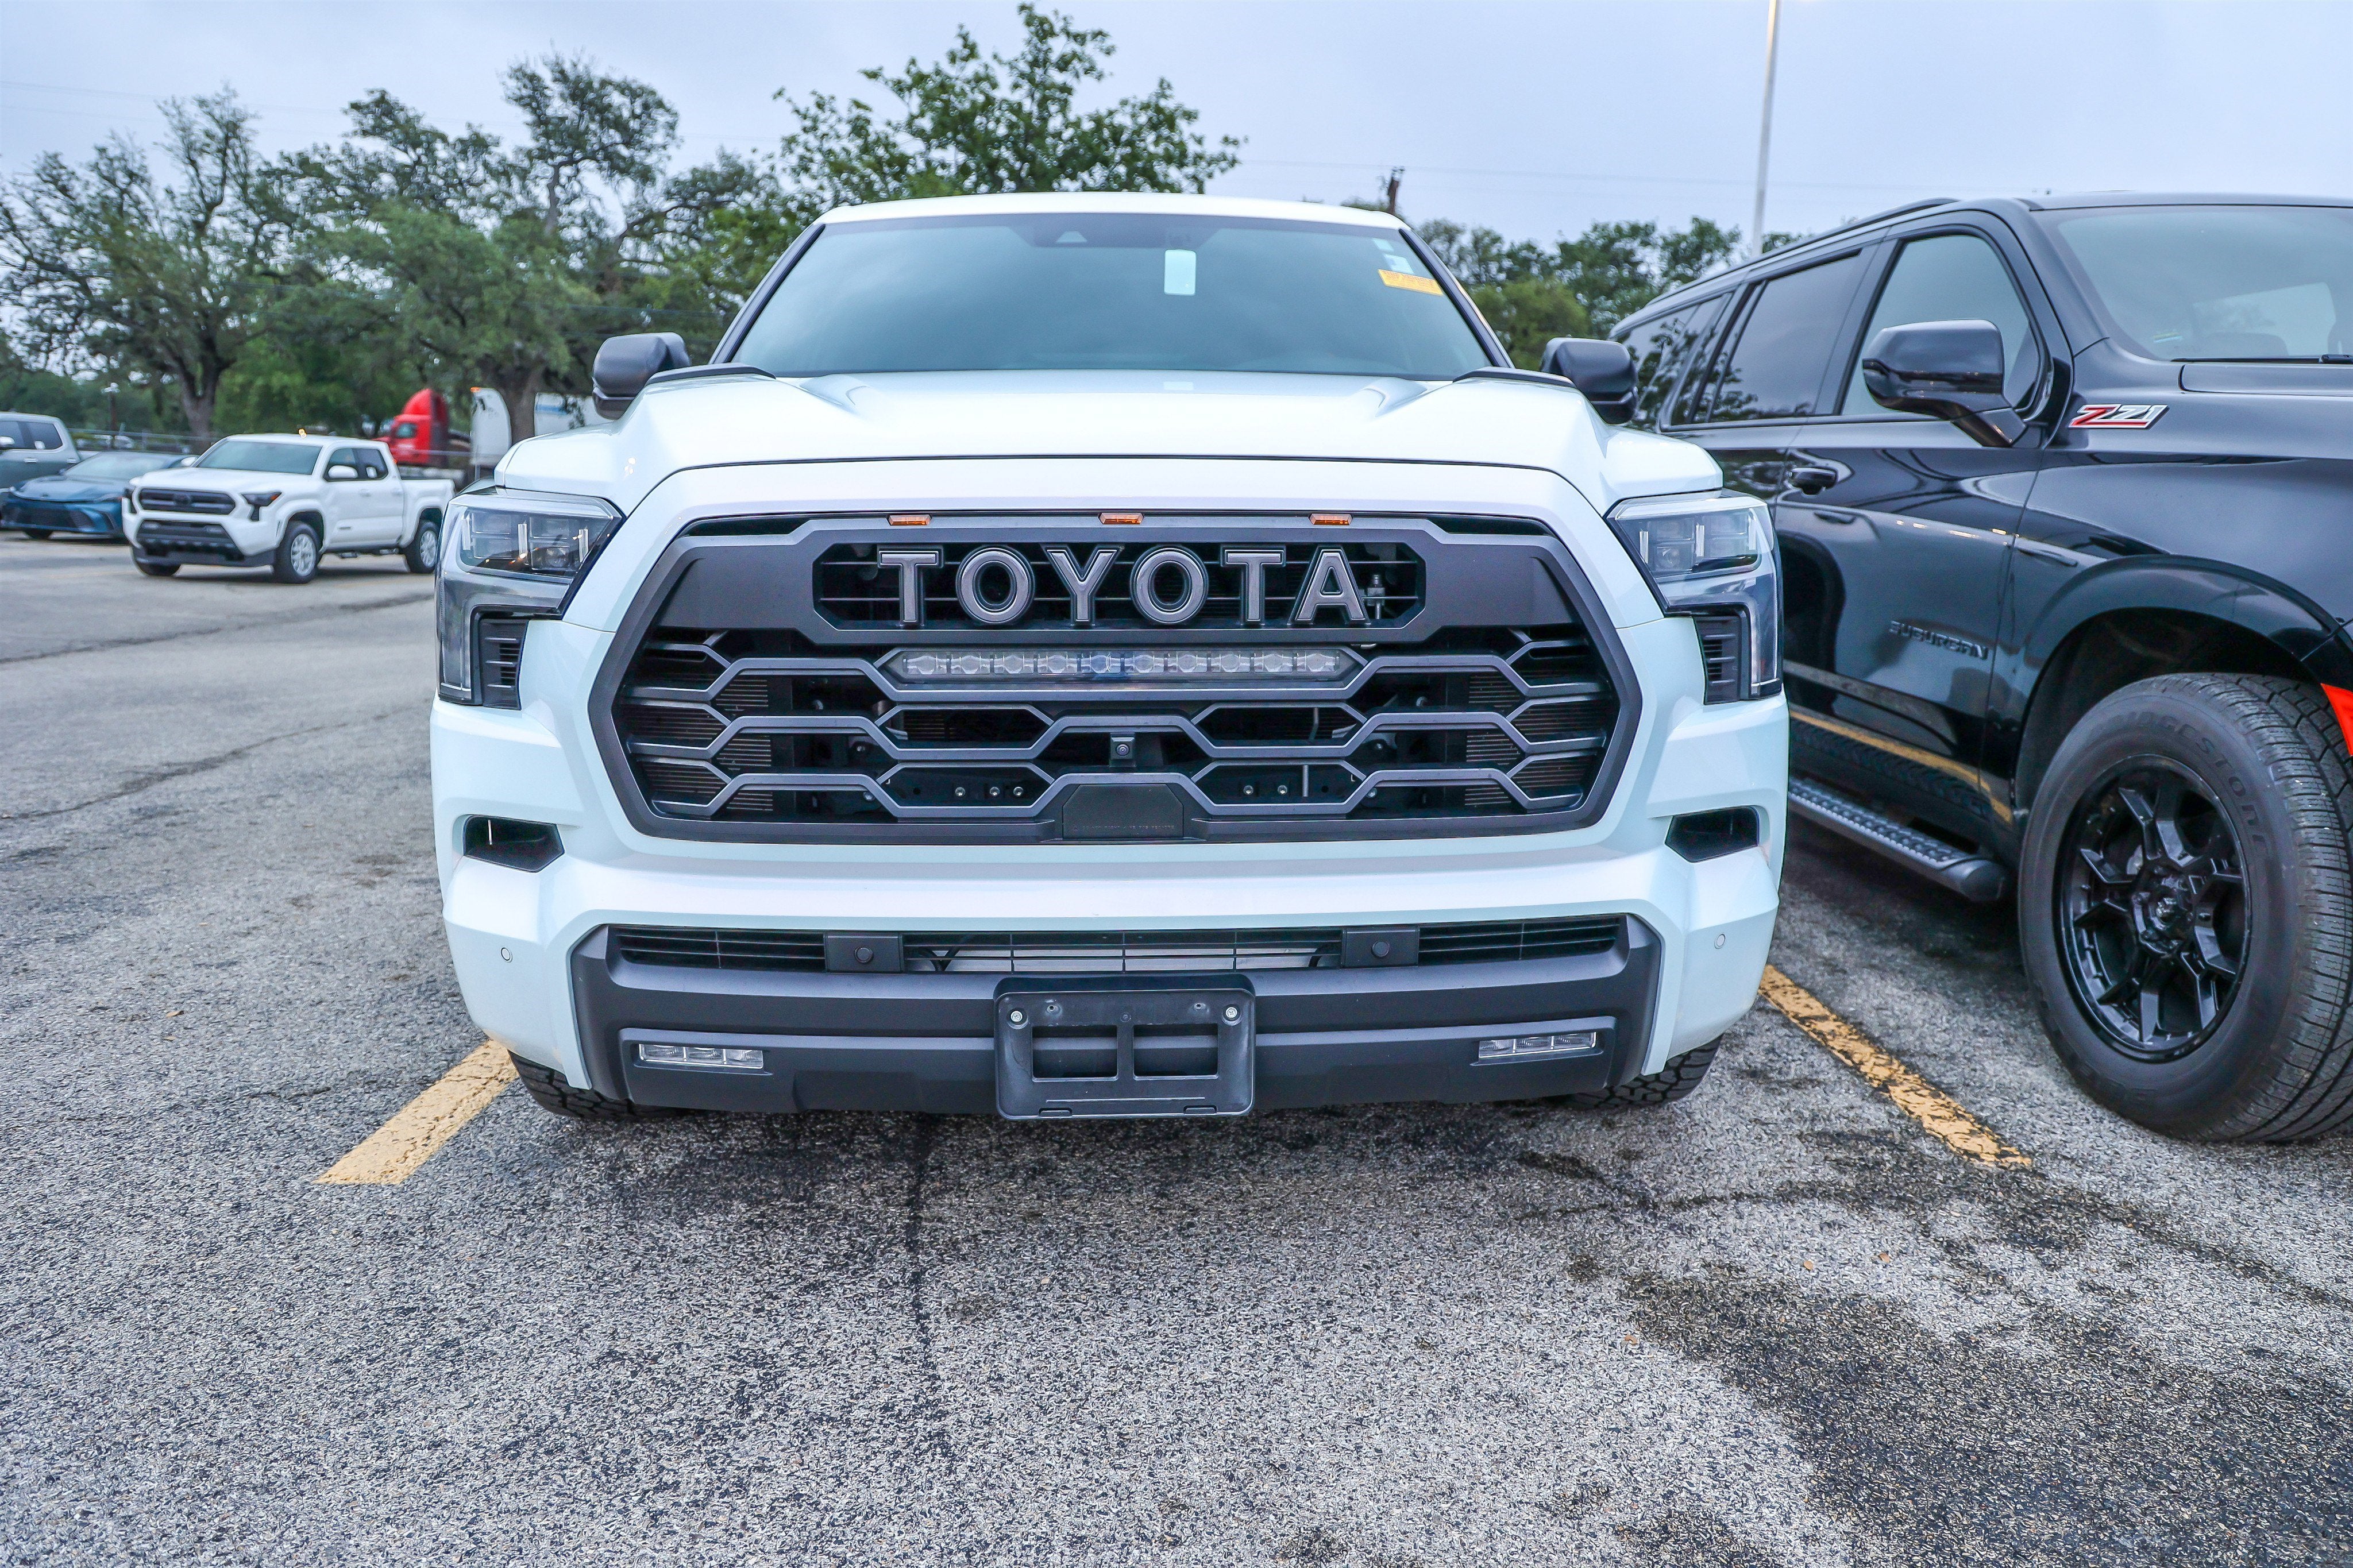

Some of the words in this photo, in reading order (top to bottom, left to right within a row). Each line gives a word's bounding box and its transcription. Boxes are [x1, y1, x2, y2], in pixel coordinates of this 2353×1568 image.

[2068, 404, 2169, 430] Z71
[877, 544, 1370, 626] TOYOTA
[2091, 711, 2269, 858] IDGESTONE
